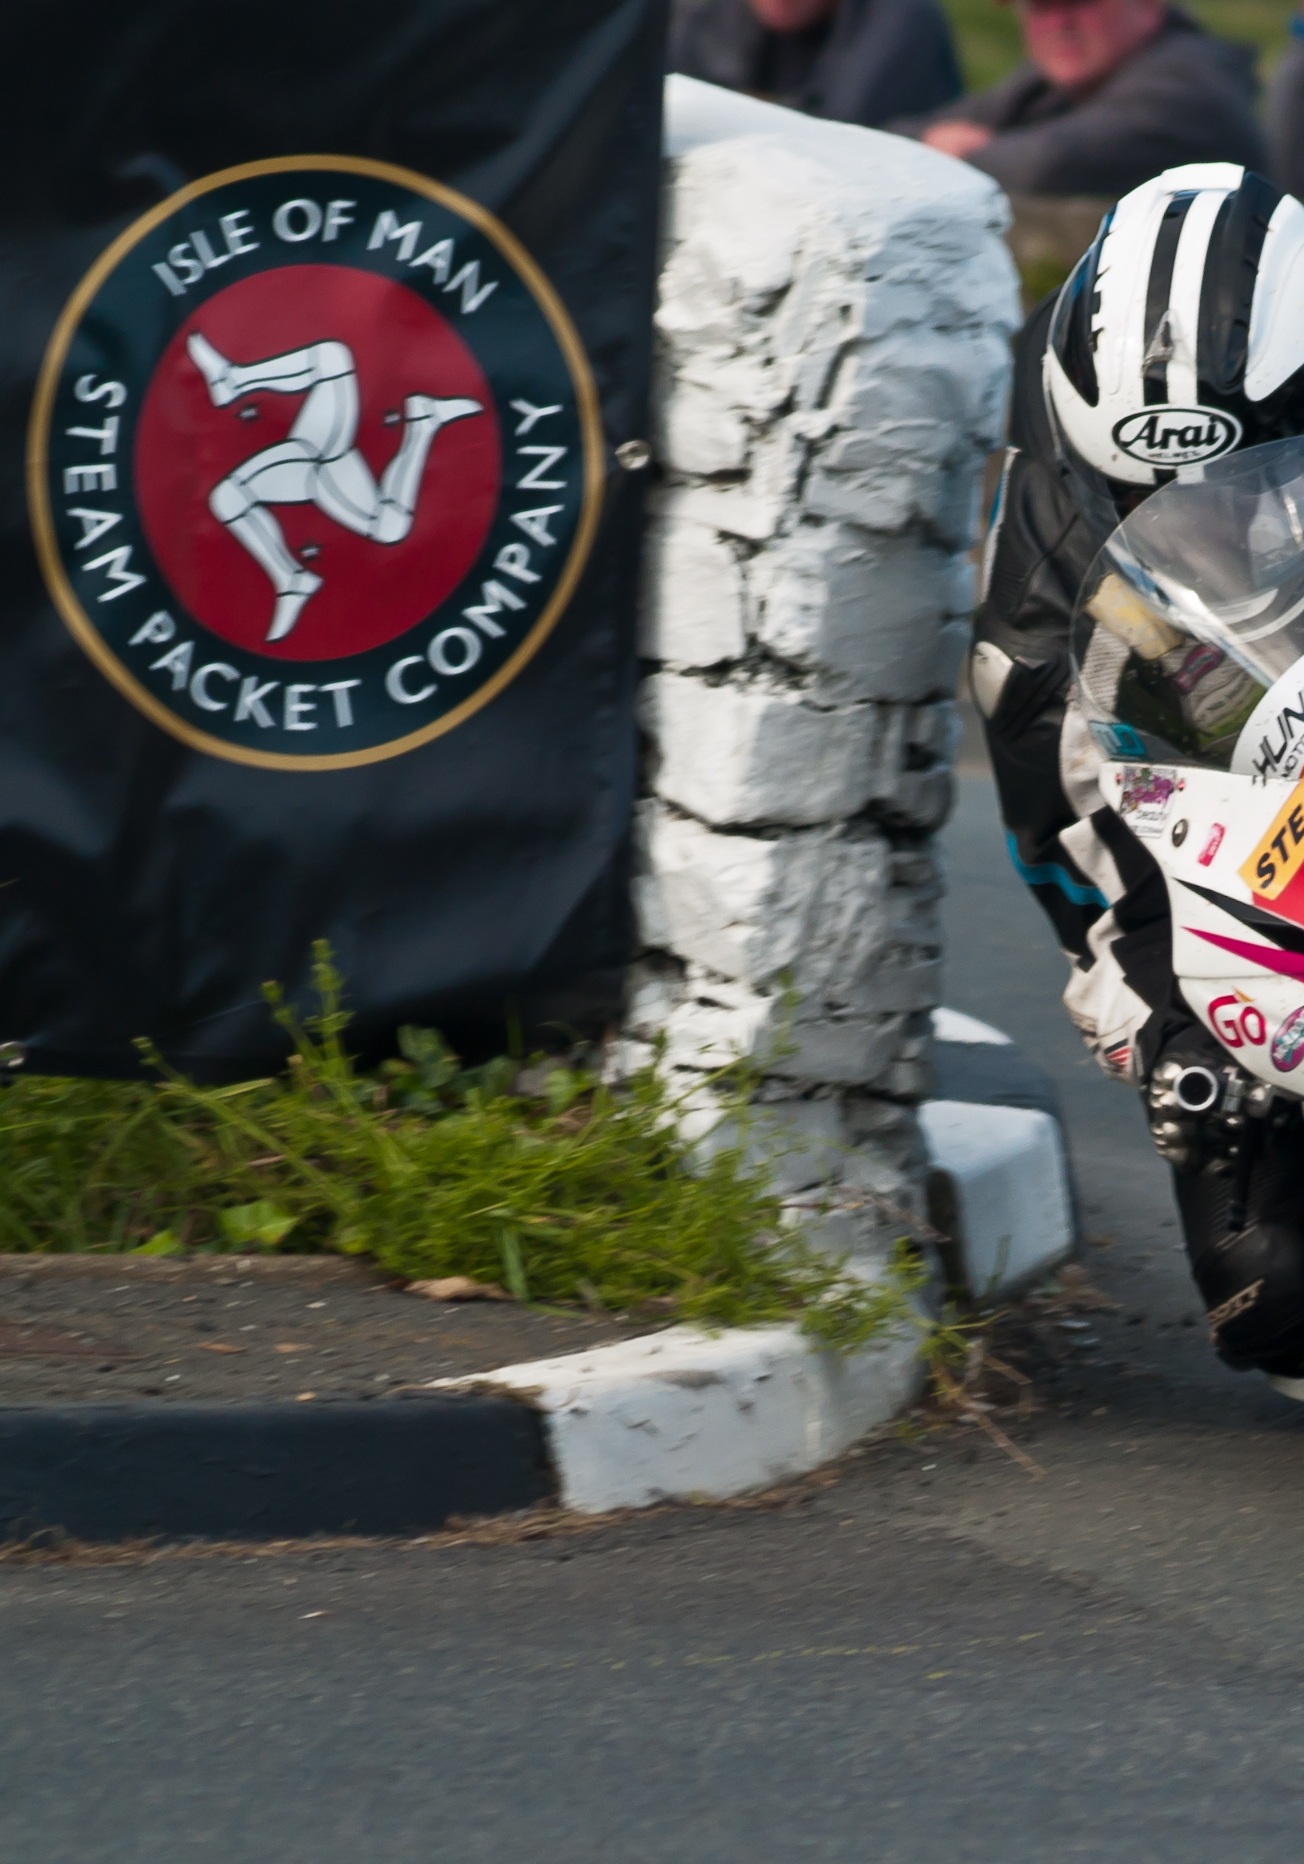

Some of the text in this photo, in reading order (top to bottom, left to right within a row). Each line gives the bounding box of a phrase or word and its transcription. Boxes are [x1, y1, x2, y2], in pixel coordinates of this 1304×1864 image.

[152, 199, 499, 314] ISLE OF MAN
[1120, 414, 1221, 450] Arai
[64, 374, 568, 731] STEAM PACKET COMPANY
